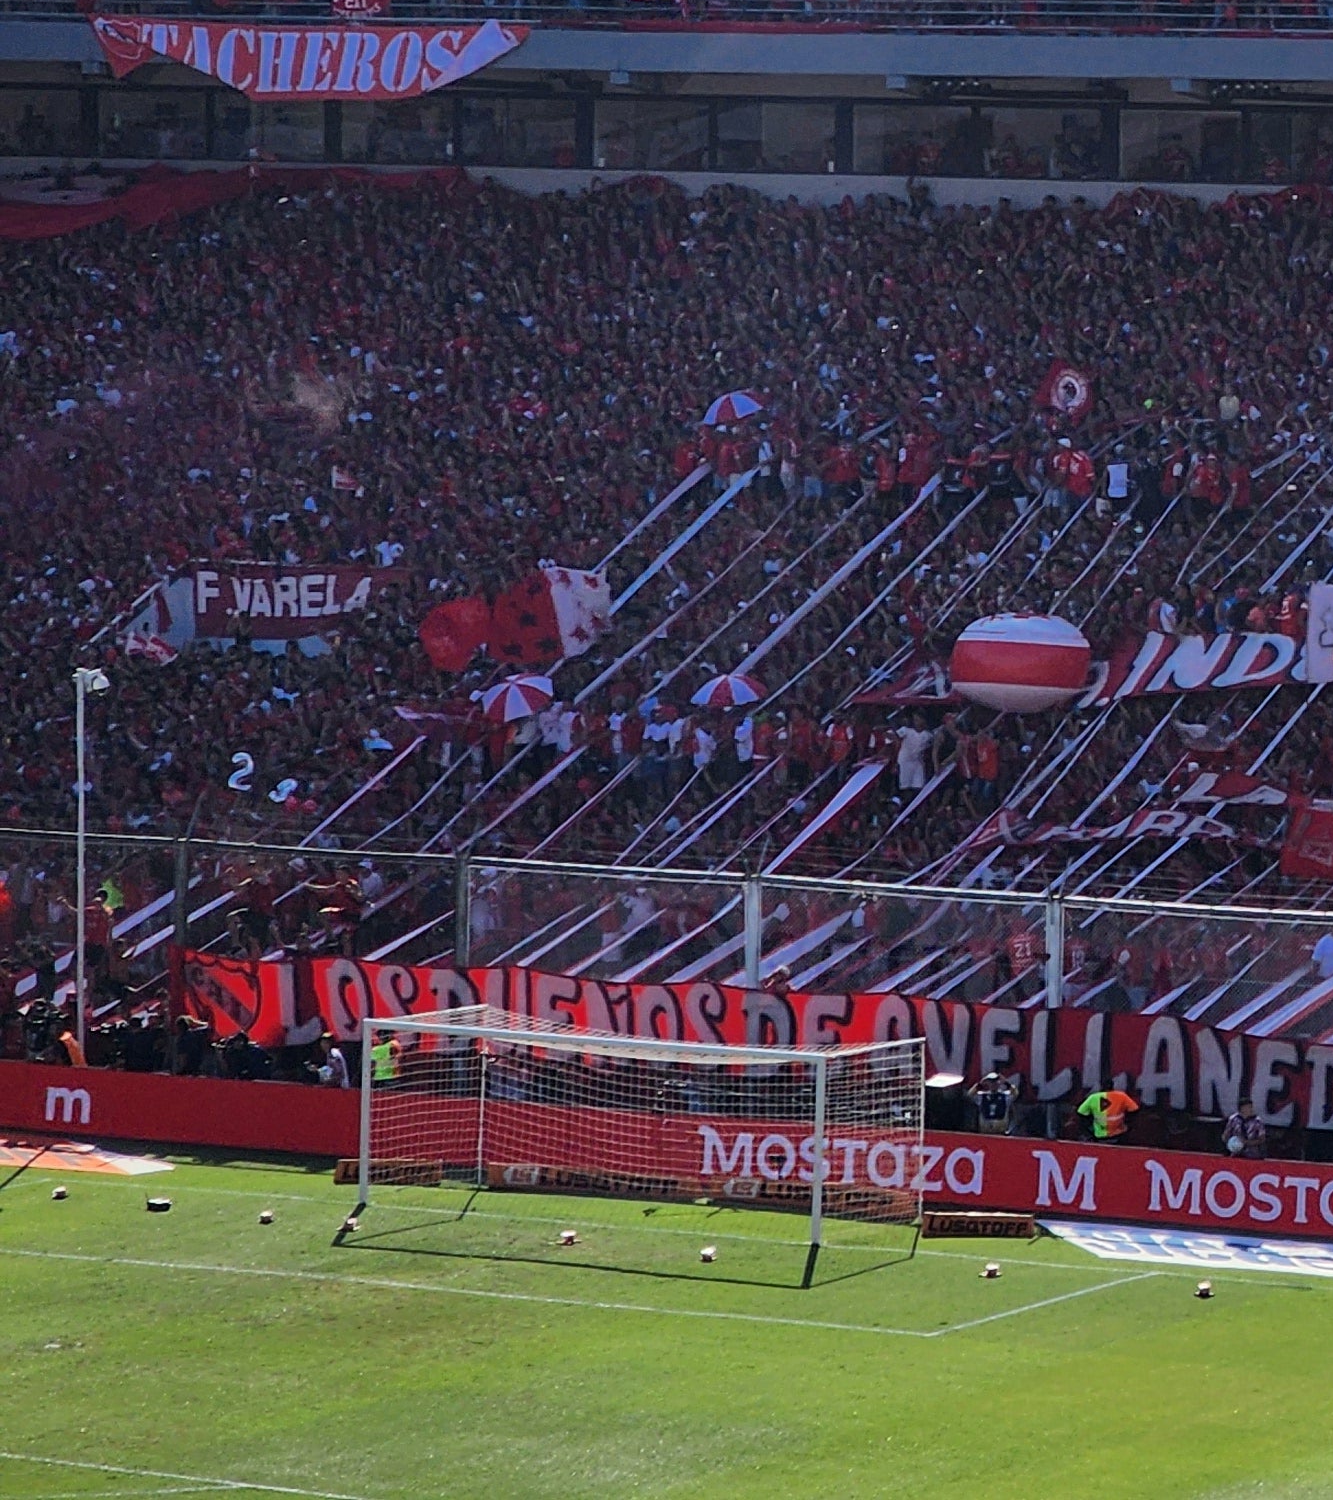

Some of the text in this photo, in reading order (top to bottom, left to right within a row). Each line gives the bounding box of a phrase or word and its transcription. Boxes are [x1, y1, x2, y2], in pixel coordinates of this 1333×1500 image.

[140, 24, 464, 93] TACHEROS
[275, 959, 418, 1049] LOS
[1033, 1150, 1099, 1211] M
